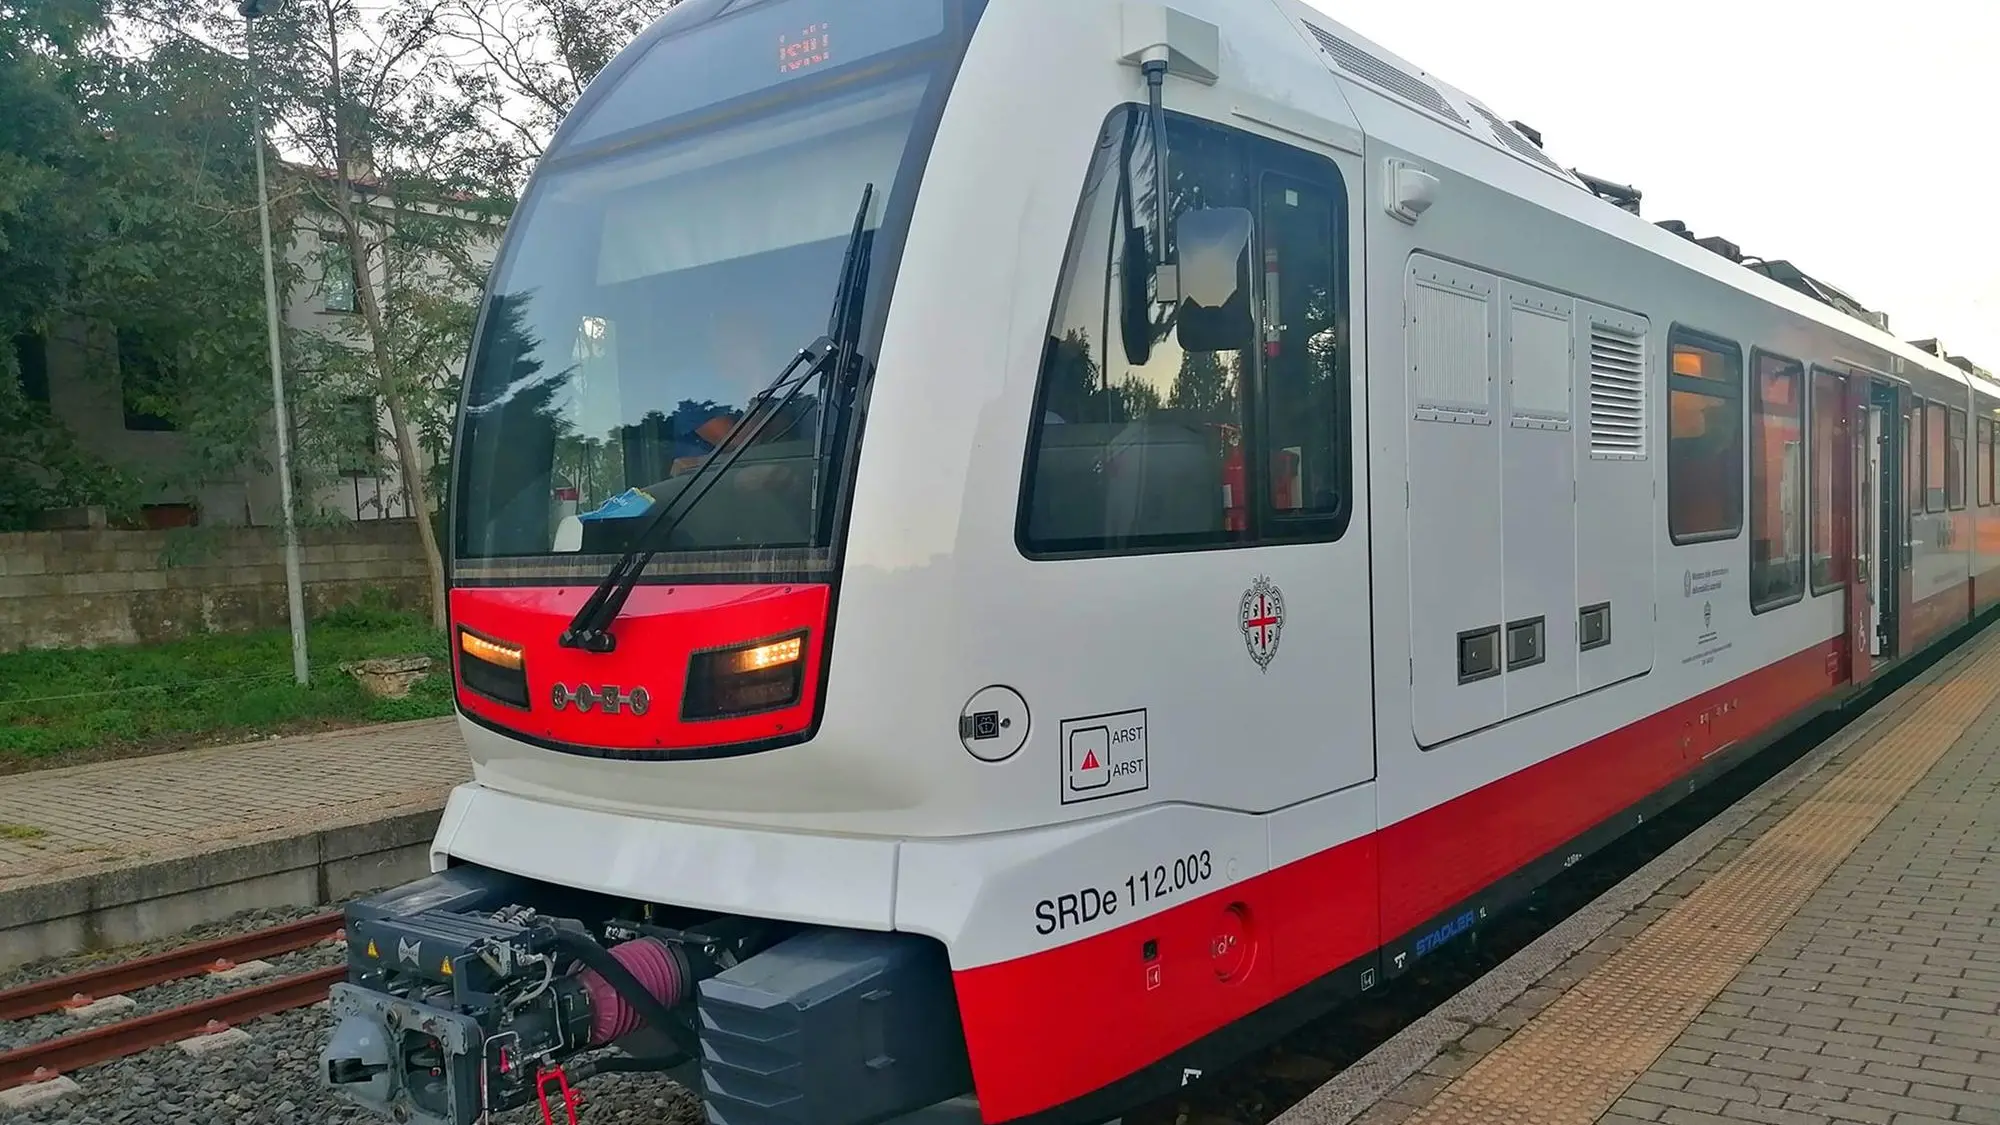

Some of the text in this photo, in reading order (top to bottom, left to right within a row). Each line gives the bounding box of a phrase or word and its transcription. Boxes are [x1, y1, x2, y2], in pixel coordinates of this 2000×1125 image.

[1112, 726, 1143, 745] ARST
[1113, 759, 1143, 777] ARST
[1035, 849, 1212, 936] SRDe 112.003
[1416, 910, 1475, 957] STADLER
